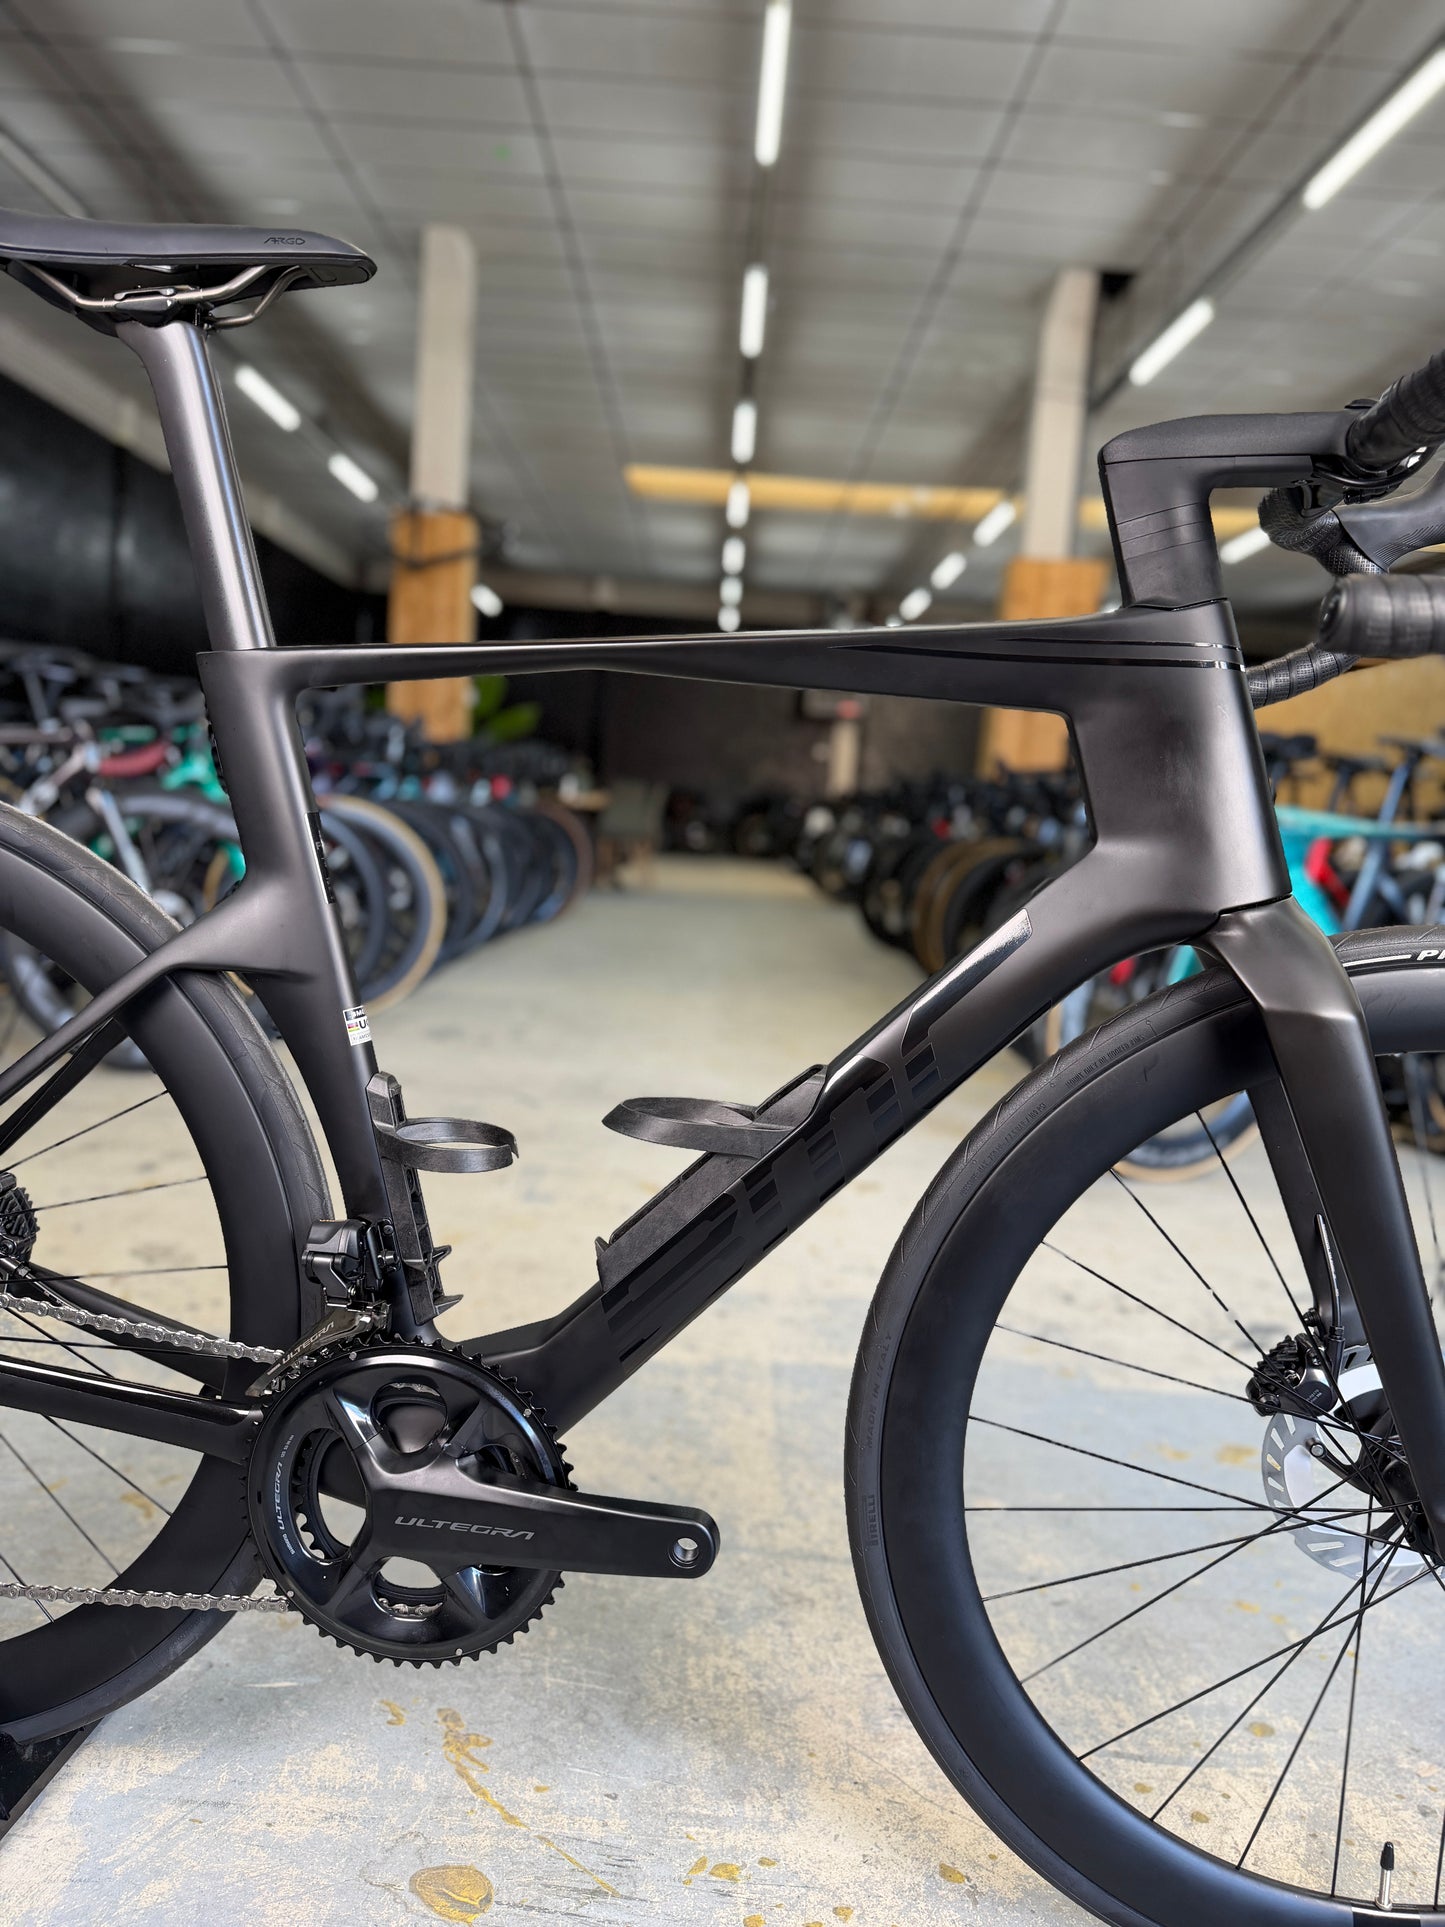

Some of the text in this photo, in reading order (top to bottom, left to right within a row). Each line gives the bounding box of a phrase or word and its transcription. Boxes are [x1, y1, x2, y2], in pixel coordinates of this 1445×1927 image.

[263, 236, 306, 246] ARGO
[281, 1321, 335, 1364] ULTEGRA
[866, 1333, 892, 1448] MADE IN ITALY
[274, 1462, 285, 1530] ULTEGRA
[394, 1516, 536, 1541] ULTEGRA
[866, 1494, 879, 1547] PIRELLI
